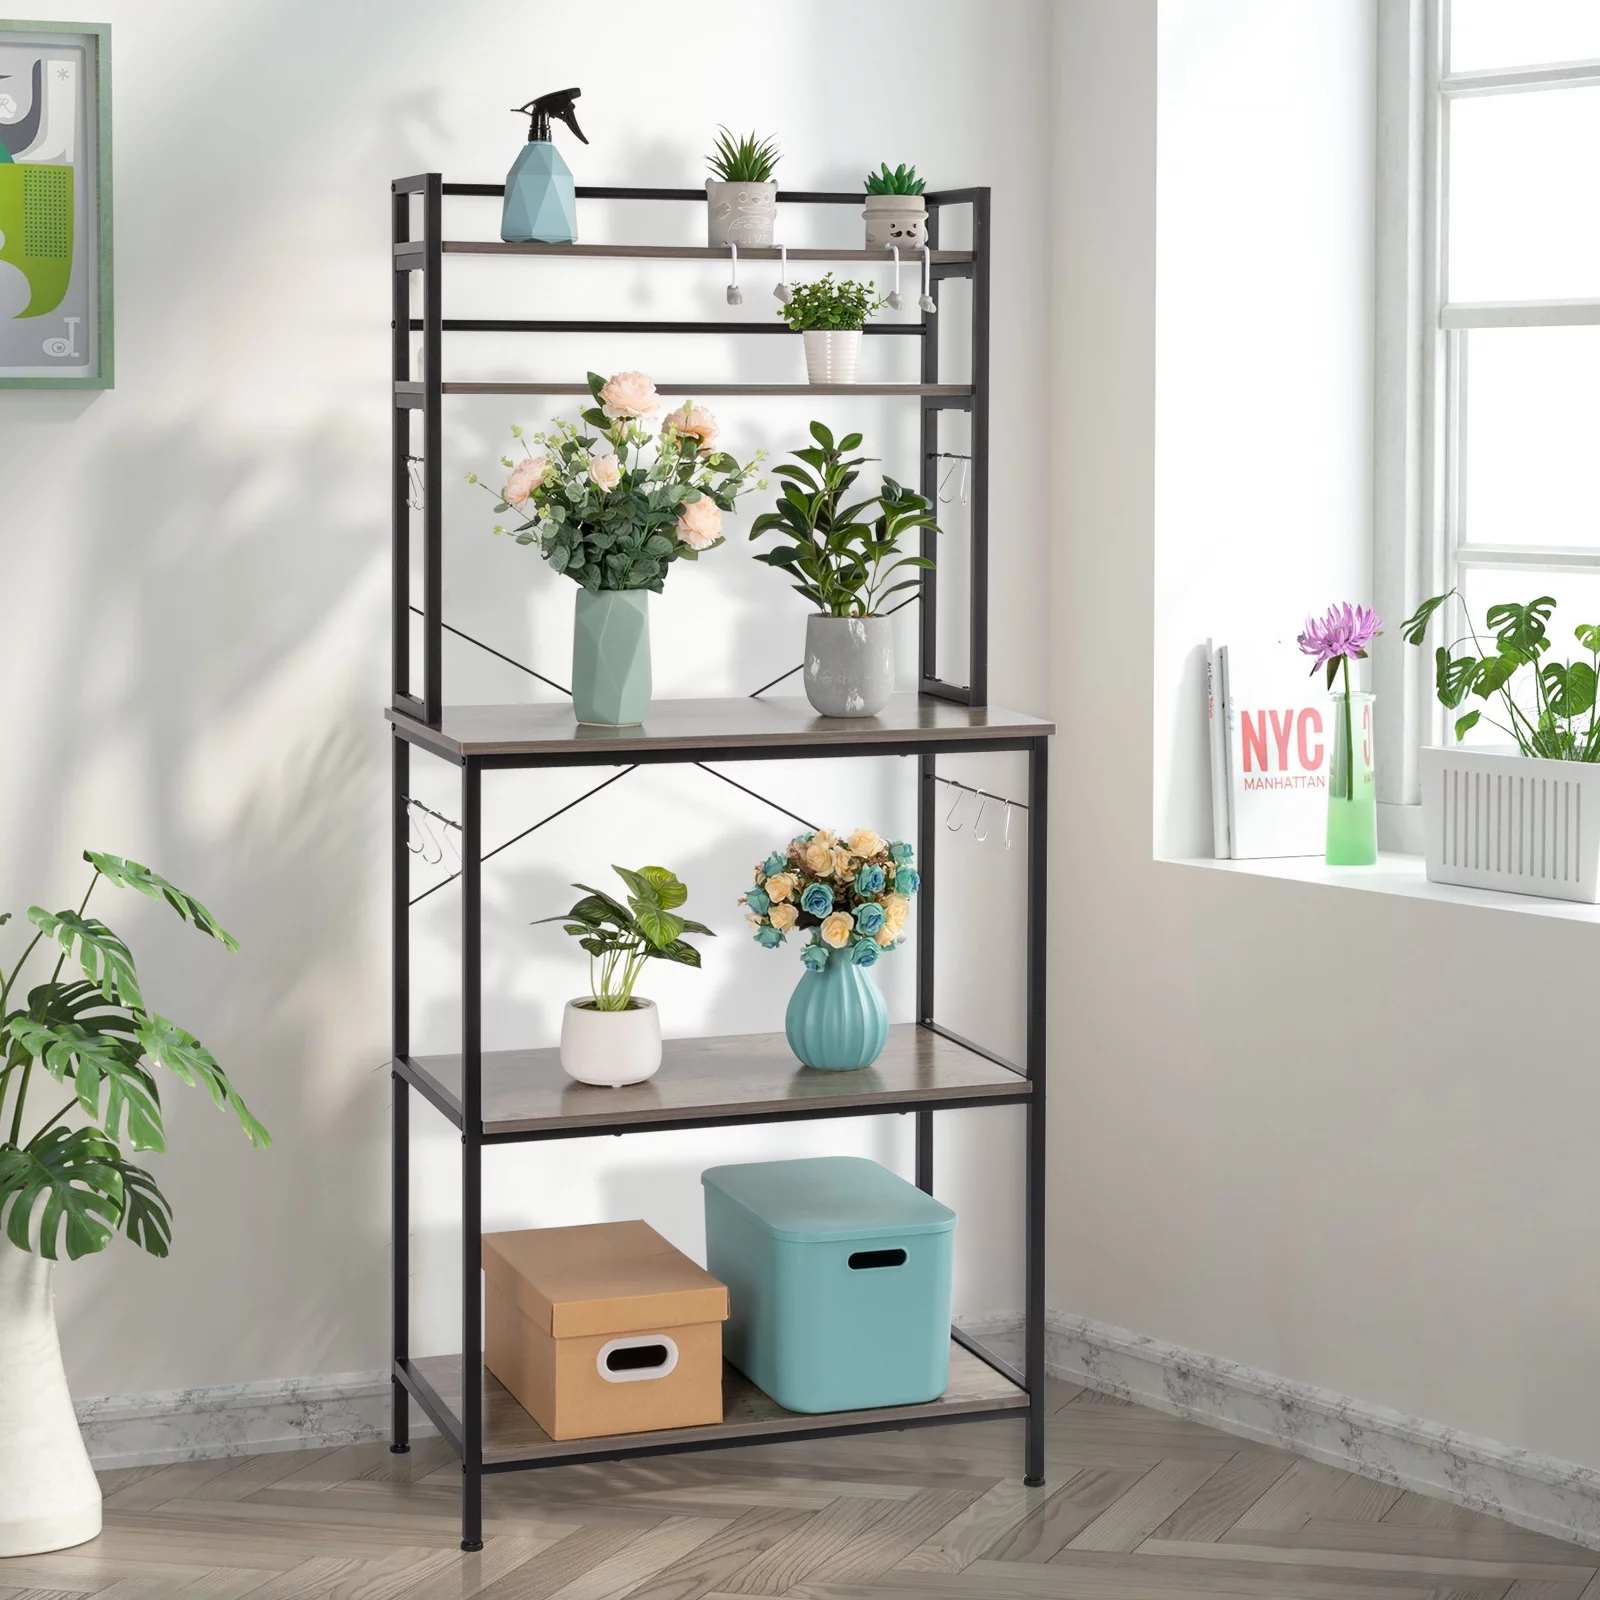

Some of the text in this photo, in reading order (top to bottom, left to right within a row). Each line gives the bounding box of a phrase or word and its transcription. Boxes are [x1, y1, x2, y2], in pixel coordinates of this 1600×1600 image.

[739, 234, 767, 243] LIVE
[1241, 707, 1324, 773] NYC
[1244, 775, 1325, 791] MANHATTAN
